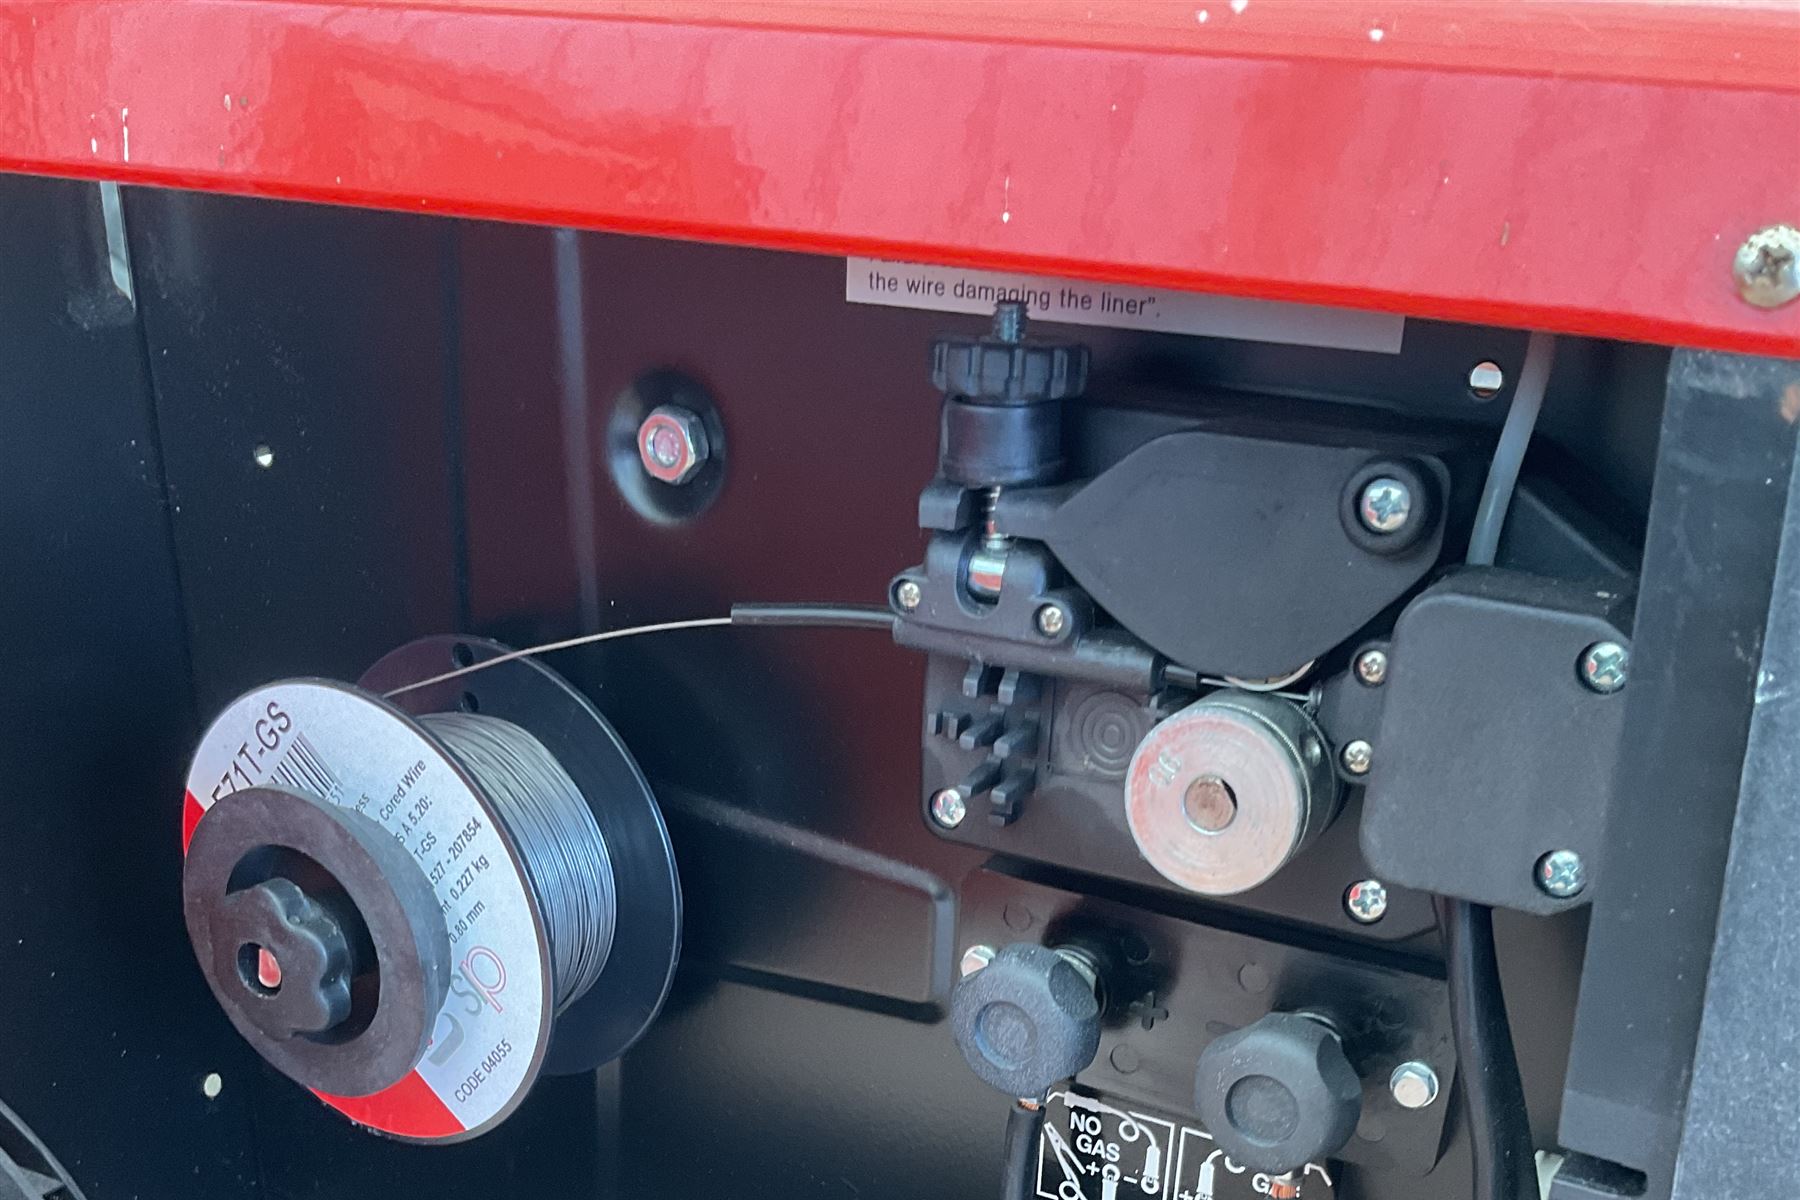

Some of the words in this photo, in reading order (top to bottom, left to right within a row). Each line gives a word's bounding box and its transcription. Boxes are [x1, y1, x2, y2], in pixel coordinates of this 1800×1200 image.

[869, 271, 898, 292] the
[906, 275, 945, 297] wire
[953, 278, 1051, 309] damaging
[1060, 288, 1092, 310] the
[379, 784, 406, 822] Cored
[401, 760, 427, 789] Wire
[448, 816, 482, 861] 207854
[449, 867, 474, 901] 0.227
[471, 855, 490, 879] kg
[466, 900, 485, 926] mm
[454, 1069, 487, 1103] CODE
[481, 1037, 512, 1073] 04055
[1070, 1111, 1101, 1136] NO
[1075, 1134, 1121, 1163] GAS
